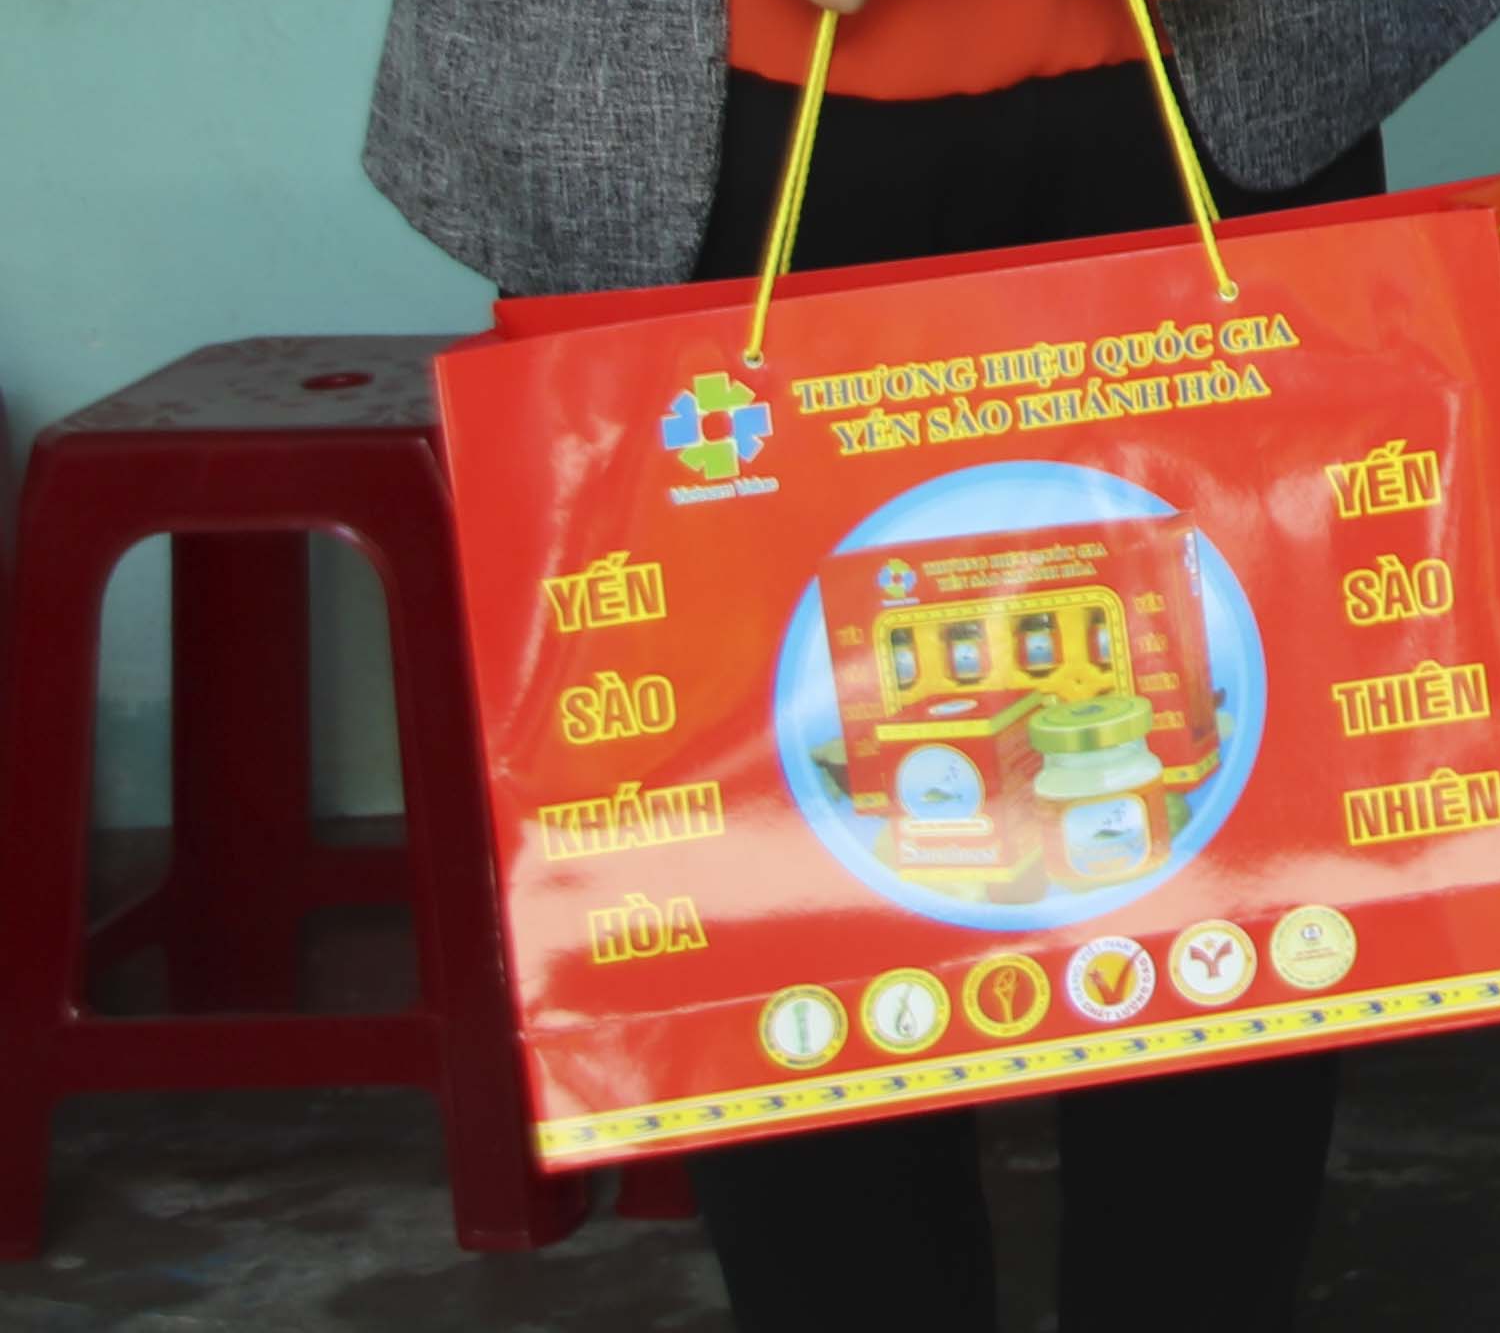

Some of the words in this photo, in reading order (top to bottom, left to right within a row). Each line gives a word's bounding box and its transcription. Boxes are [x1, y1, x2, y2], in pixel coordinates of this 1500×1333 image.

[792, 358, 975, 417] THƯƠNG
[983, 341, 1086, 393] HIỆU
[1091, 321, 1213, 375] QUỐC
[1217, 314, 1299, 354] GIA
[831, 408, 920, 456] YẾN
[925, 397, 1013, 445] SÀO
[1017, 376, 1171, 429] KHÁNH
[1175, 363, 1271, 407] HÒA
[1324, 439, 1442, 519] YẾN
[543, 550, 667, 633] YẾN
[1343, 554, 1454, 626] SÀO
[560, 671, 677, 745] SÀO
[1332, 659, 1491, 737] THIÊN
[538, 780, 725, 861] KHÁNH
[587, 892, 709, 964] HÒA
